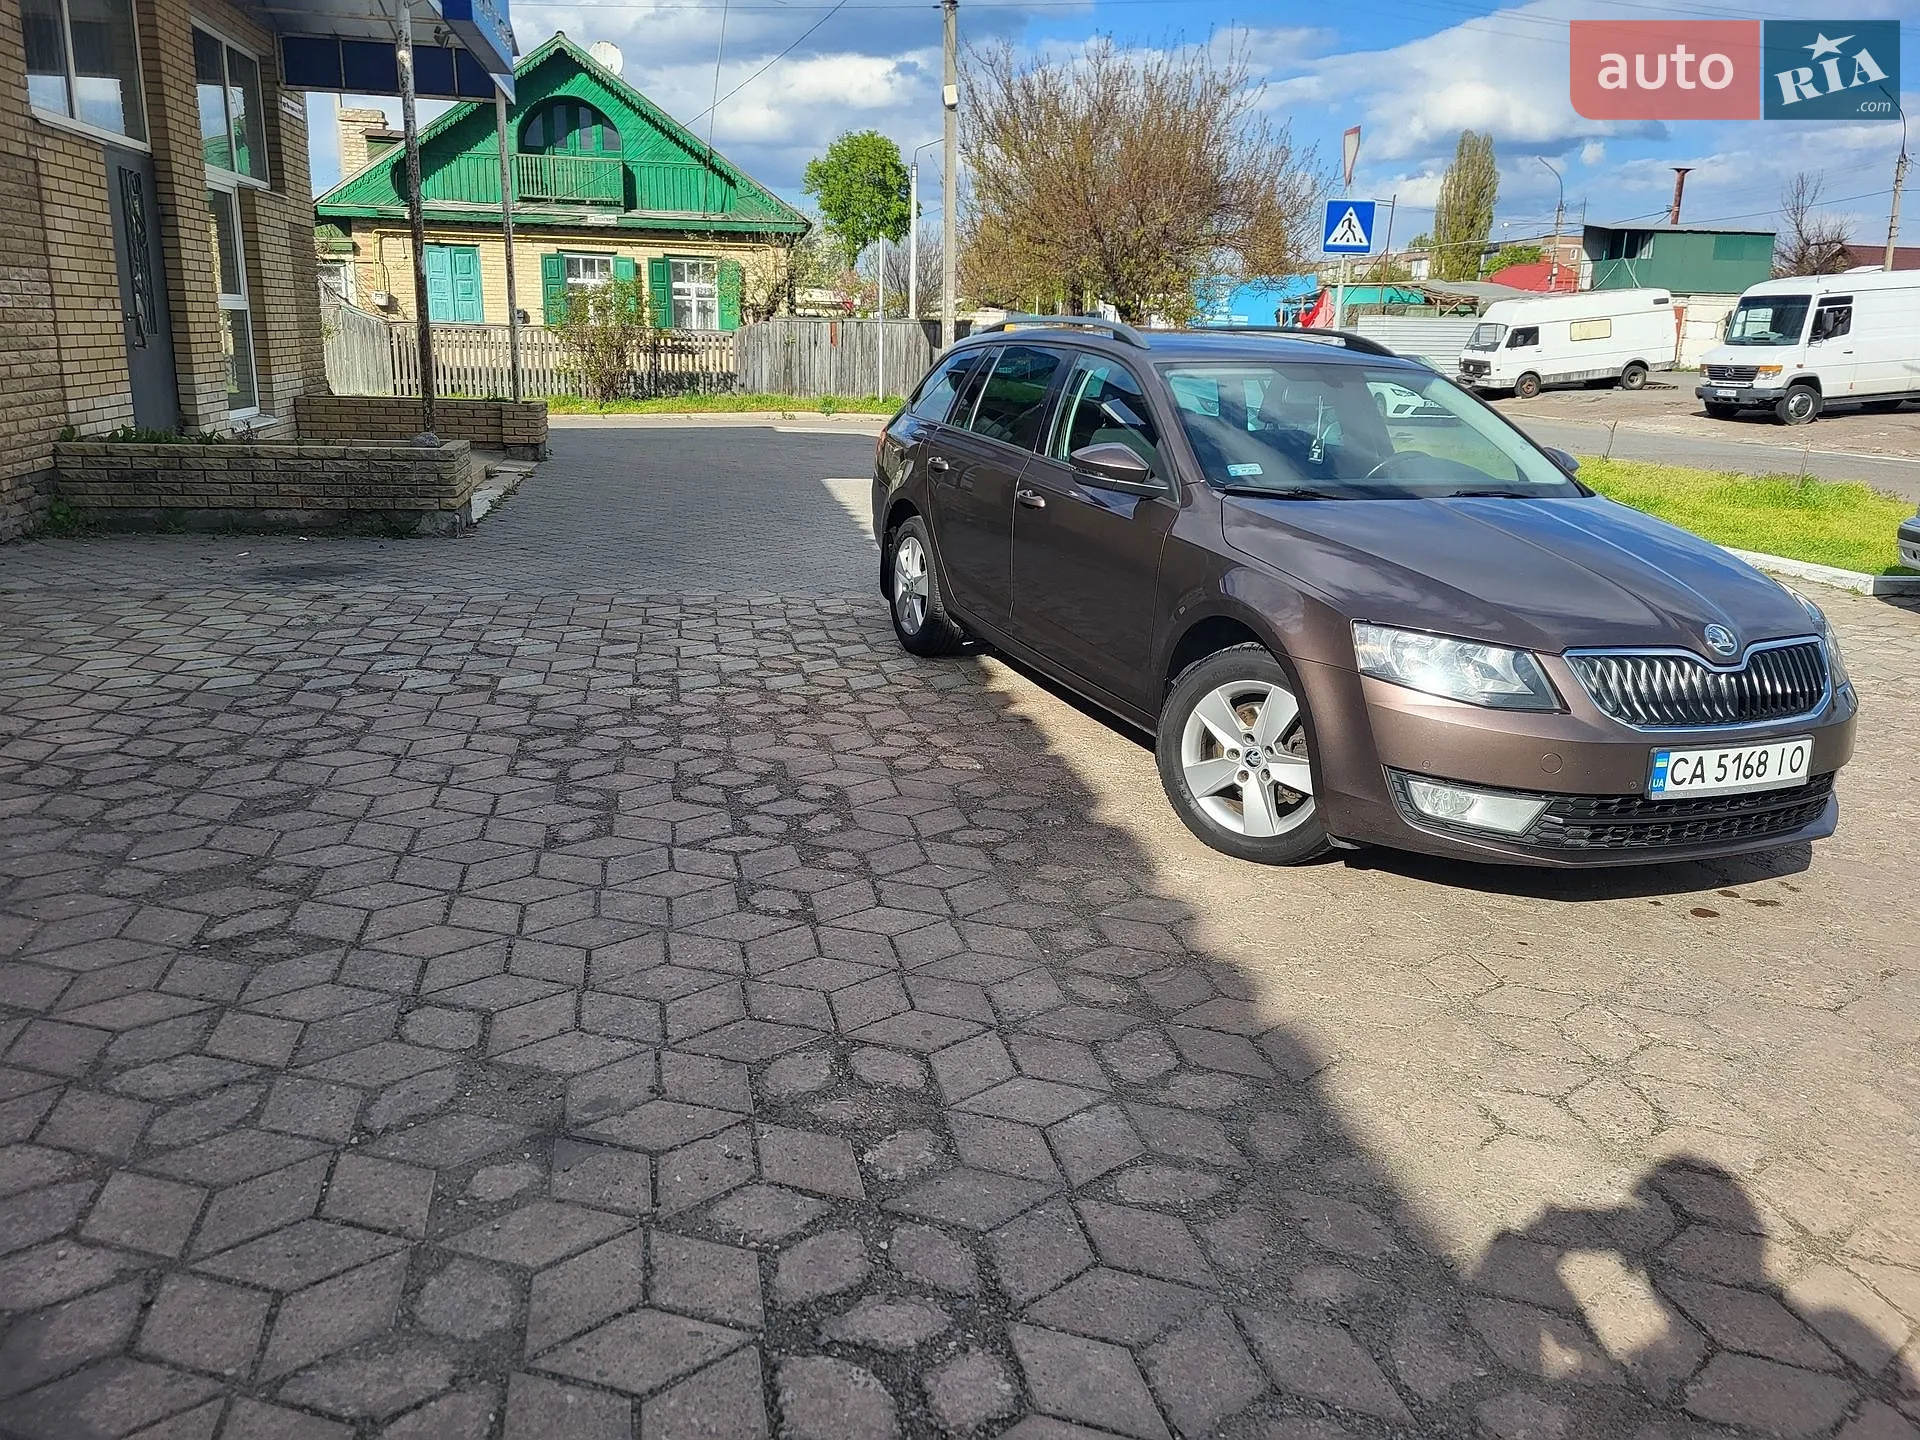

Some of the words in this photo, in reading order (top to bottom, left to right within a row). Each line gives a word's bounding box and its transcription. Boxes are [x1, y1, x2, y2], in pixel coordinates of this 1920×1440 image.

[1670, 756, 1706, 786] CA
[1714, 749, 1769, 782] 5168
[1778, 745, 1804, 776] IO
[1652, 778, 1664, 788] UA
